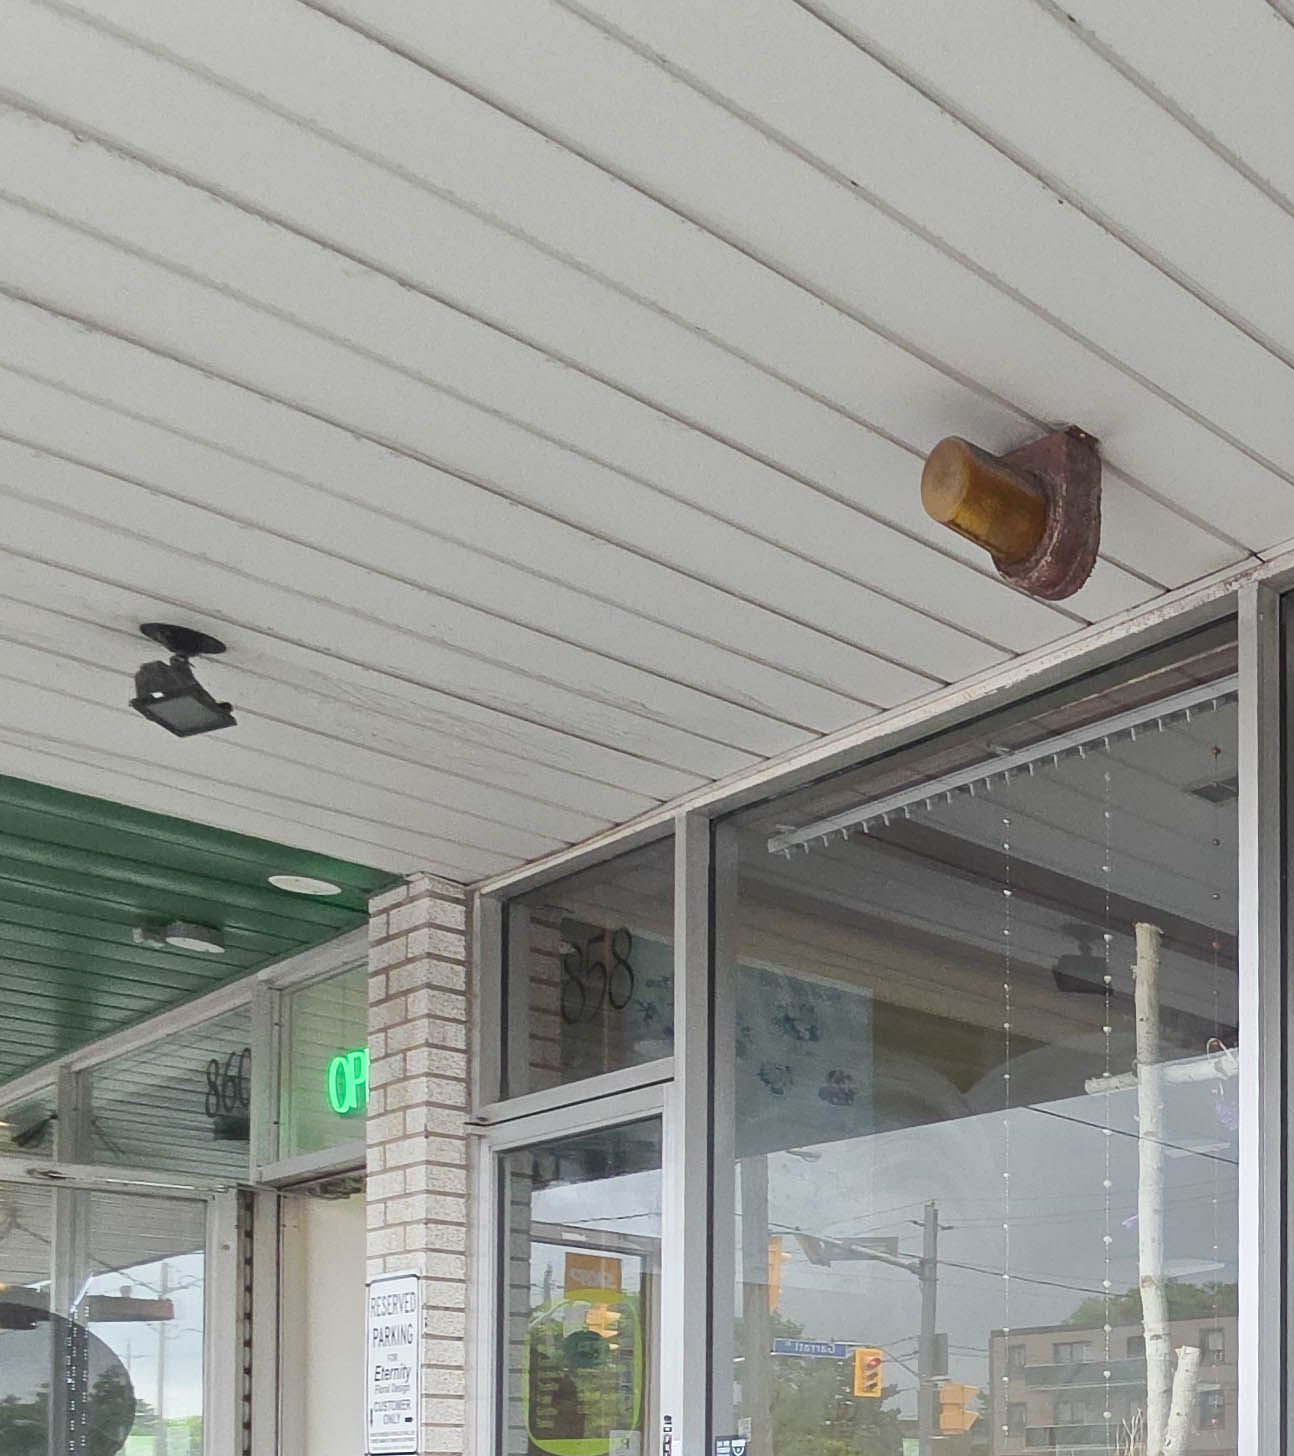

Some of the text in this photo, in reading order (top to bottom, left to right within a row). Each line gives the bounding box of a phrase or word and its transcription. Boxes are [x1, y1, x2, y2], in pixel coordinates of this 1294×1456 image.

[561, 926, 634, 1024] 858
[328, 1048, 370, 1113] OP
[371, 1292, 416, 1317] RESERVED
[373, 1324, 414, 1347] PARKING
[374, 1364, 412, 1384] Eternity
[374, 1399, 412, 1412] CUSTOMER
[384, 1413, 401, 1425] ONLY
